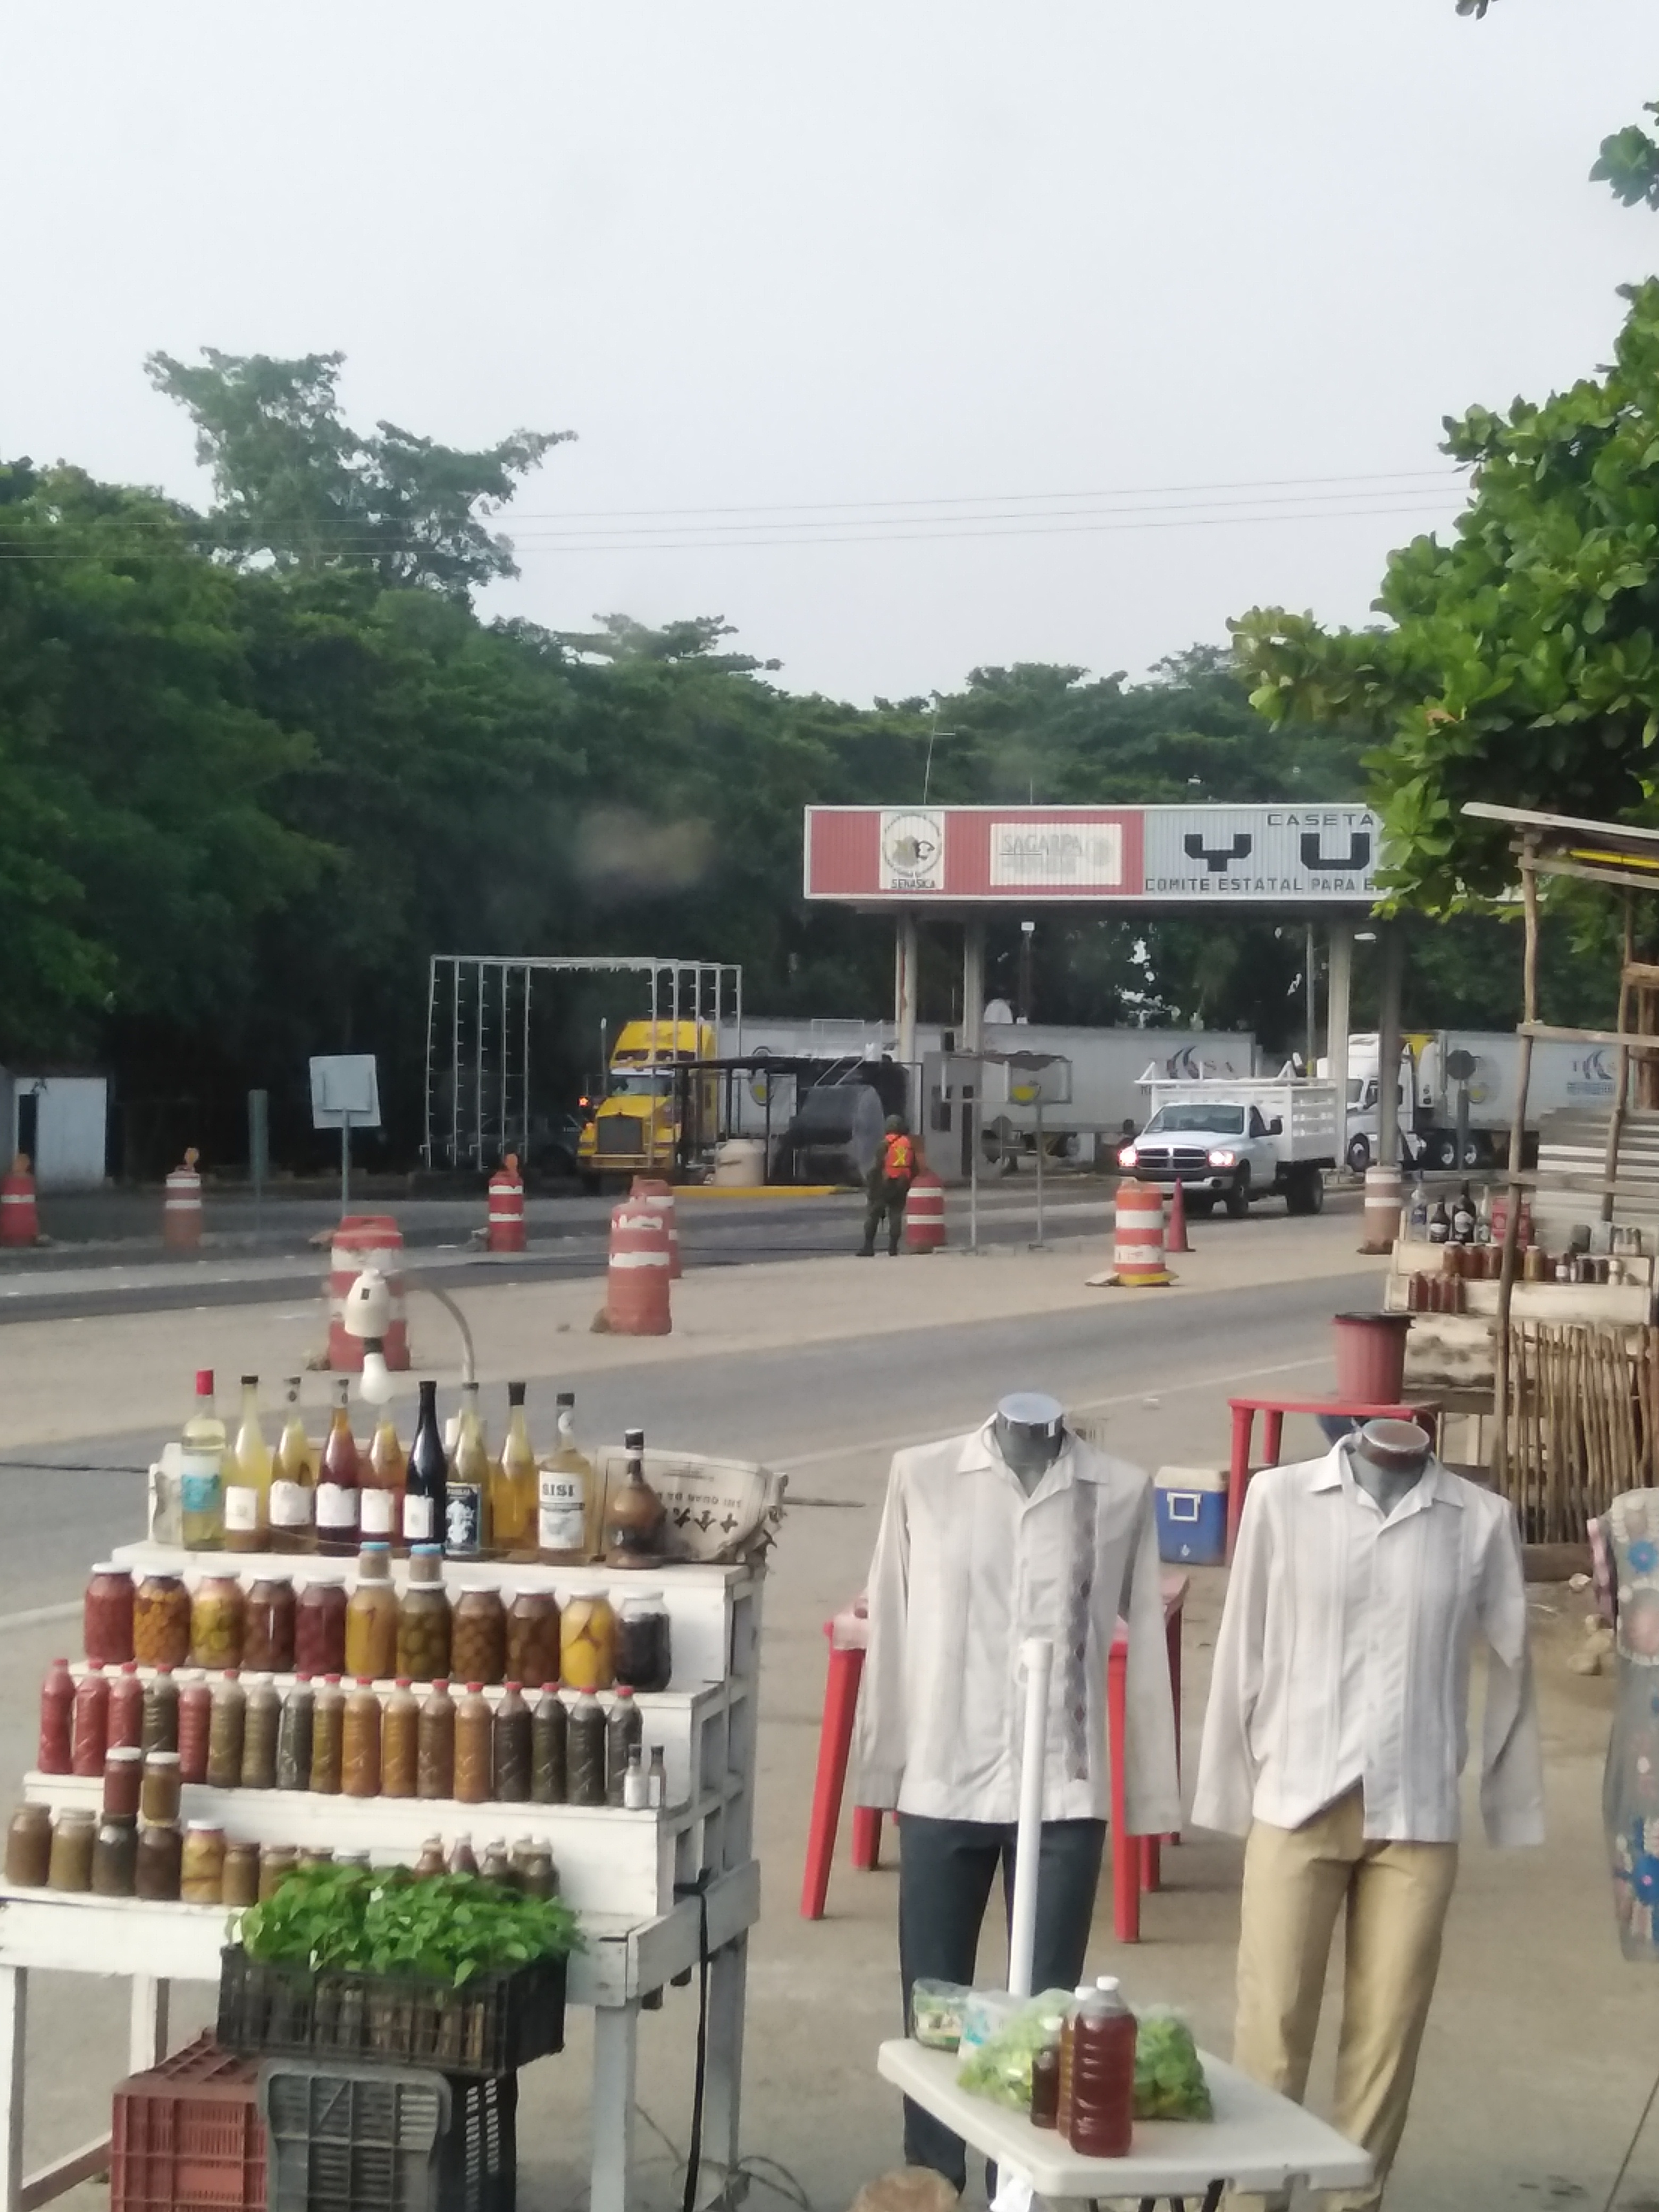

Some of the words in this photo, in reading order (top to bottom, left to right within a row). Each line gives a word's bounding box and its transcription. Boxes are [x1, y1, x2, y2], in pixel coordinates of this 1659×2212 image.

[1268, 814, 1373, 825] CASETA
[1145, 878, 1210, 891] COMITE
[1219, 878, 1303, 891] ESTATAL
[1312, 878, 1355, 891] PARA
